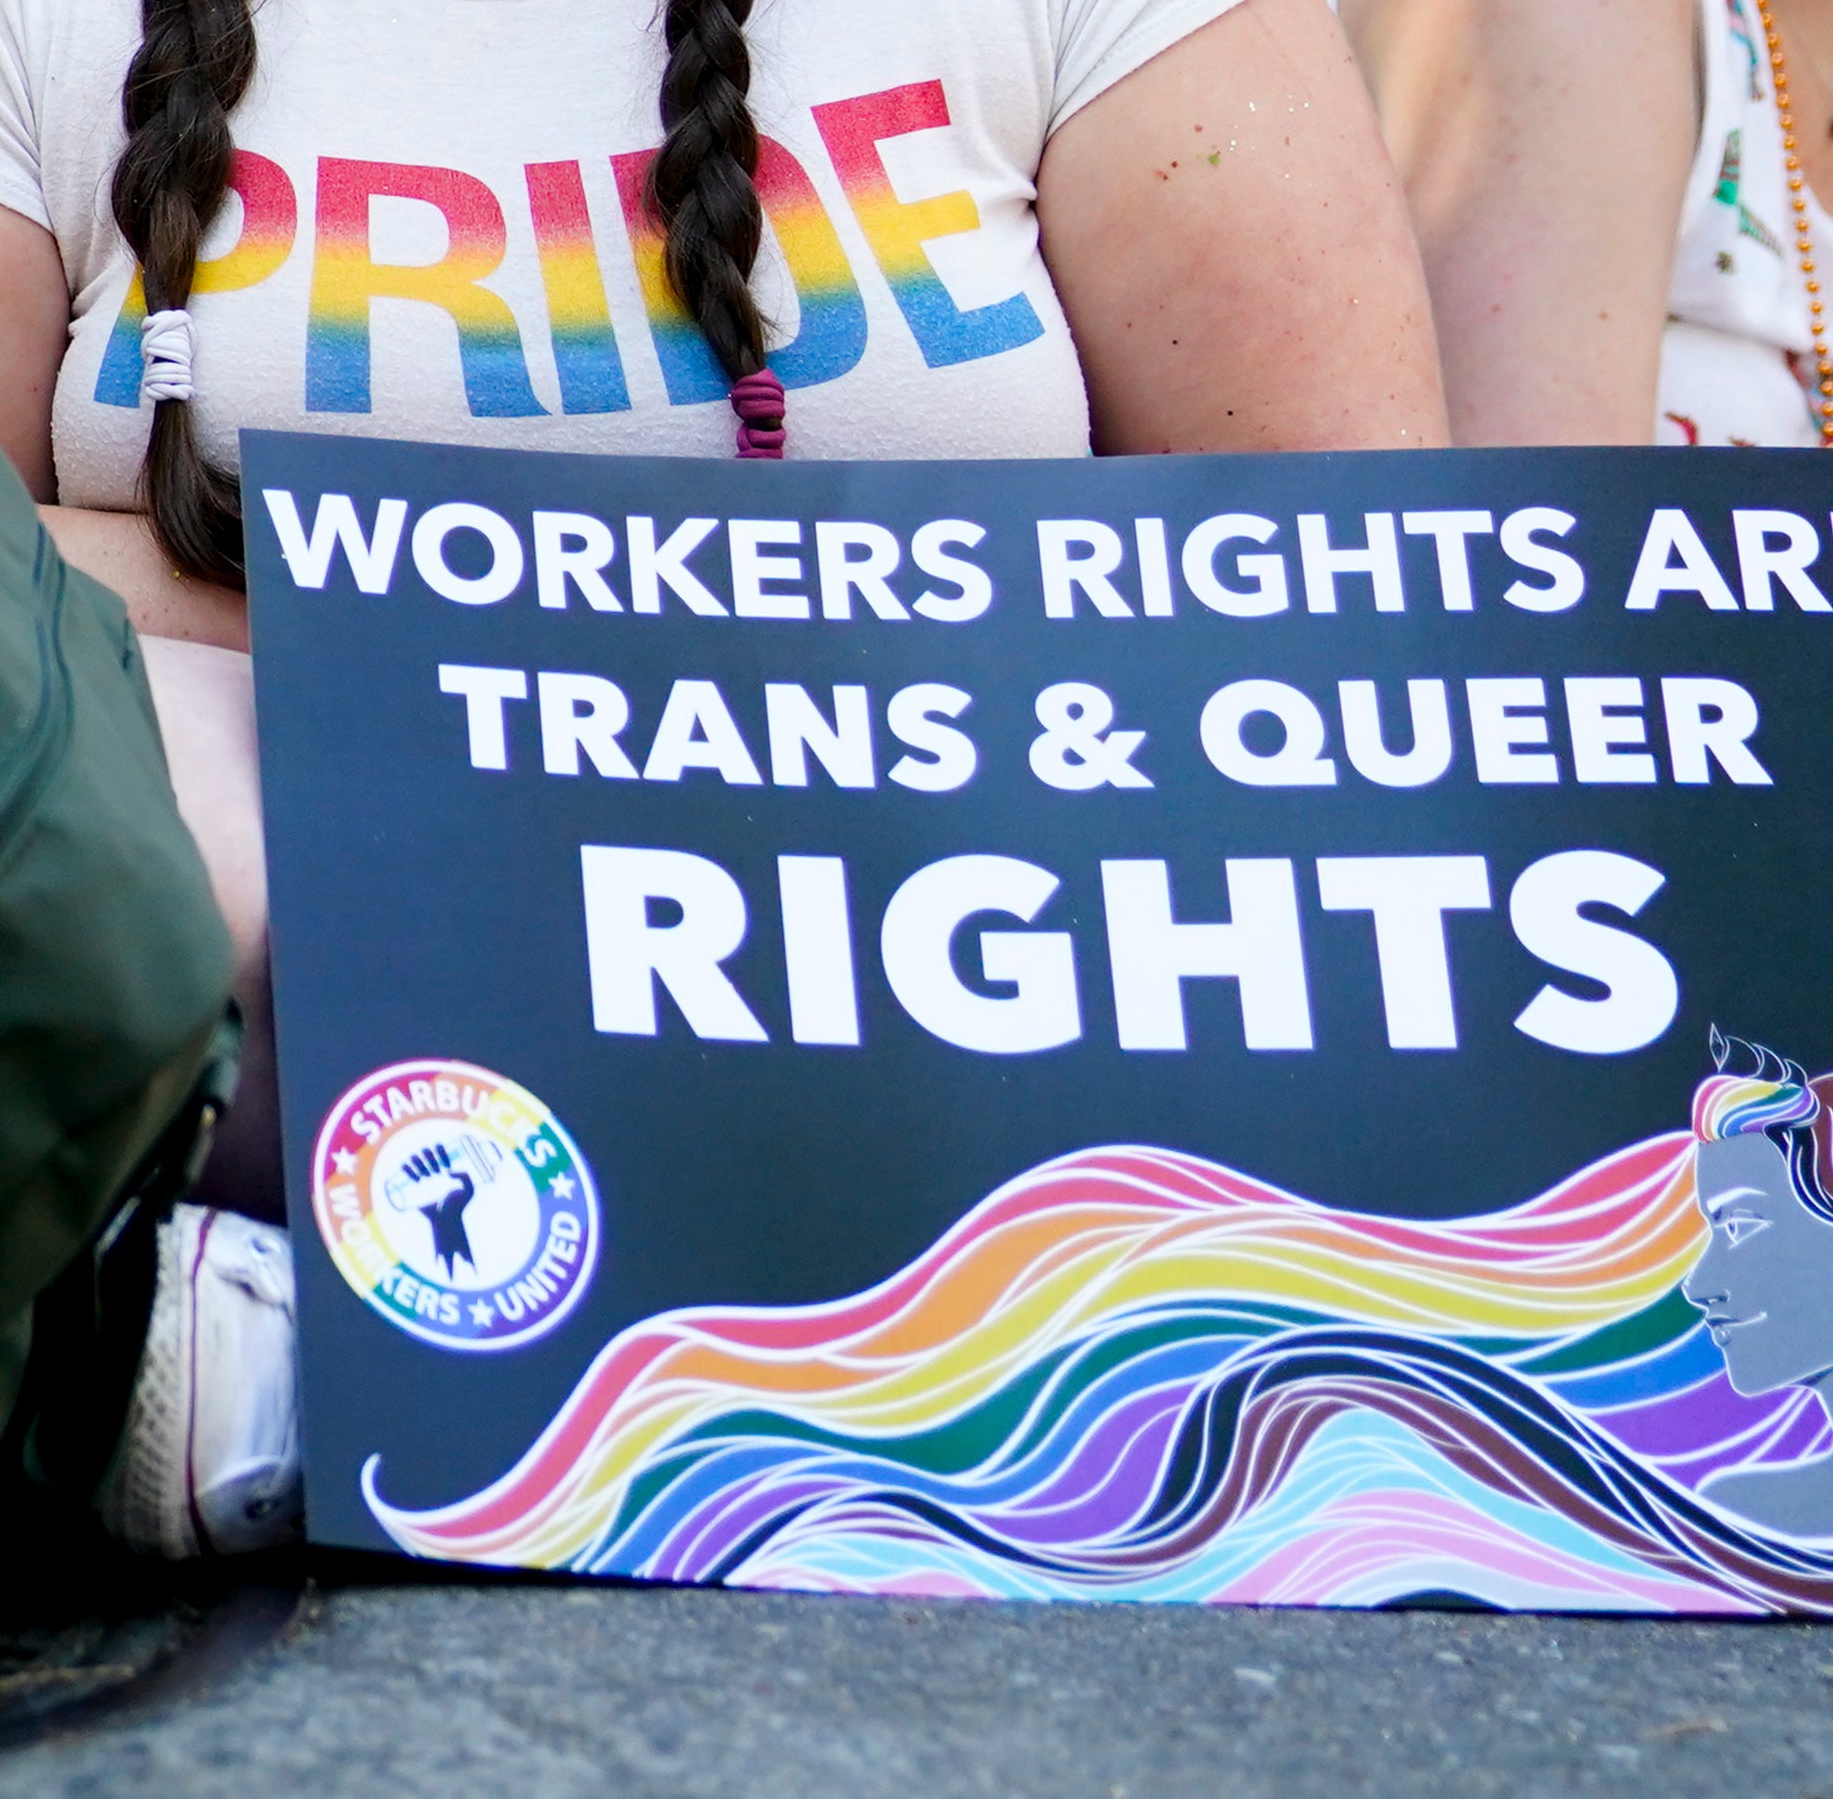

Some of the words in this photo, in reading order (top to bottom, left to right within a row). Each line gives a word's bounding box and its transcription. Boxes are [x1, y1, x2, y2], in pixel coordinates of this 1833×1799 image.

[94, 79, 1046, 418] PRIDE
[261, 488, 994, 623] WORKERS
[1036, 506, 1586, 619] RIGHTS
[1624, 508, 1833, 613] AR
[438, 663, 978, 792] TRANS
[1028, 681, 1156, 791] &
[1199, 677, 1775, 788] QUEER
[580, 844, 1679, 1055] RIGHTS
[350, 1079, 558, 1169] STARBUCKS
[493, 1210, 583, 1322] UNITED
